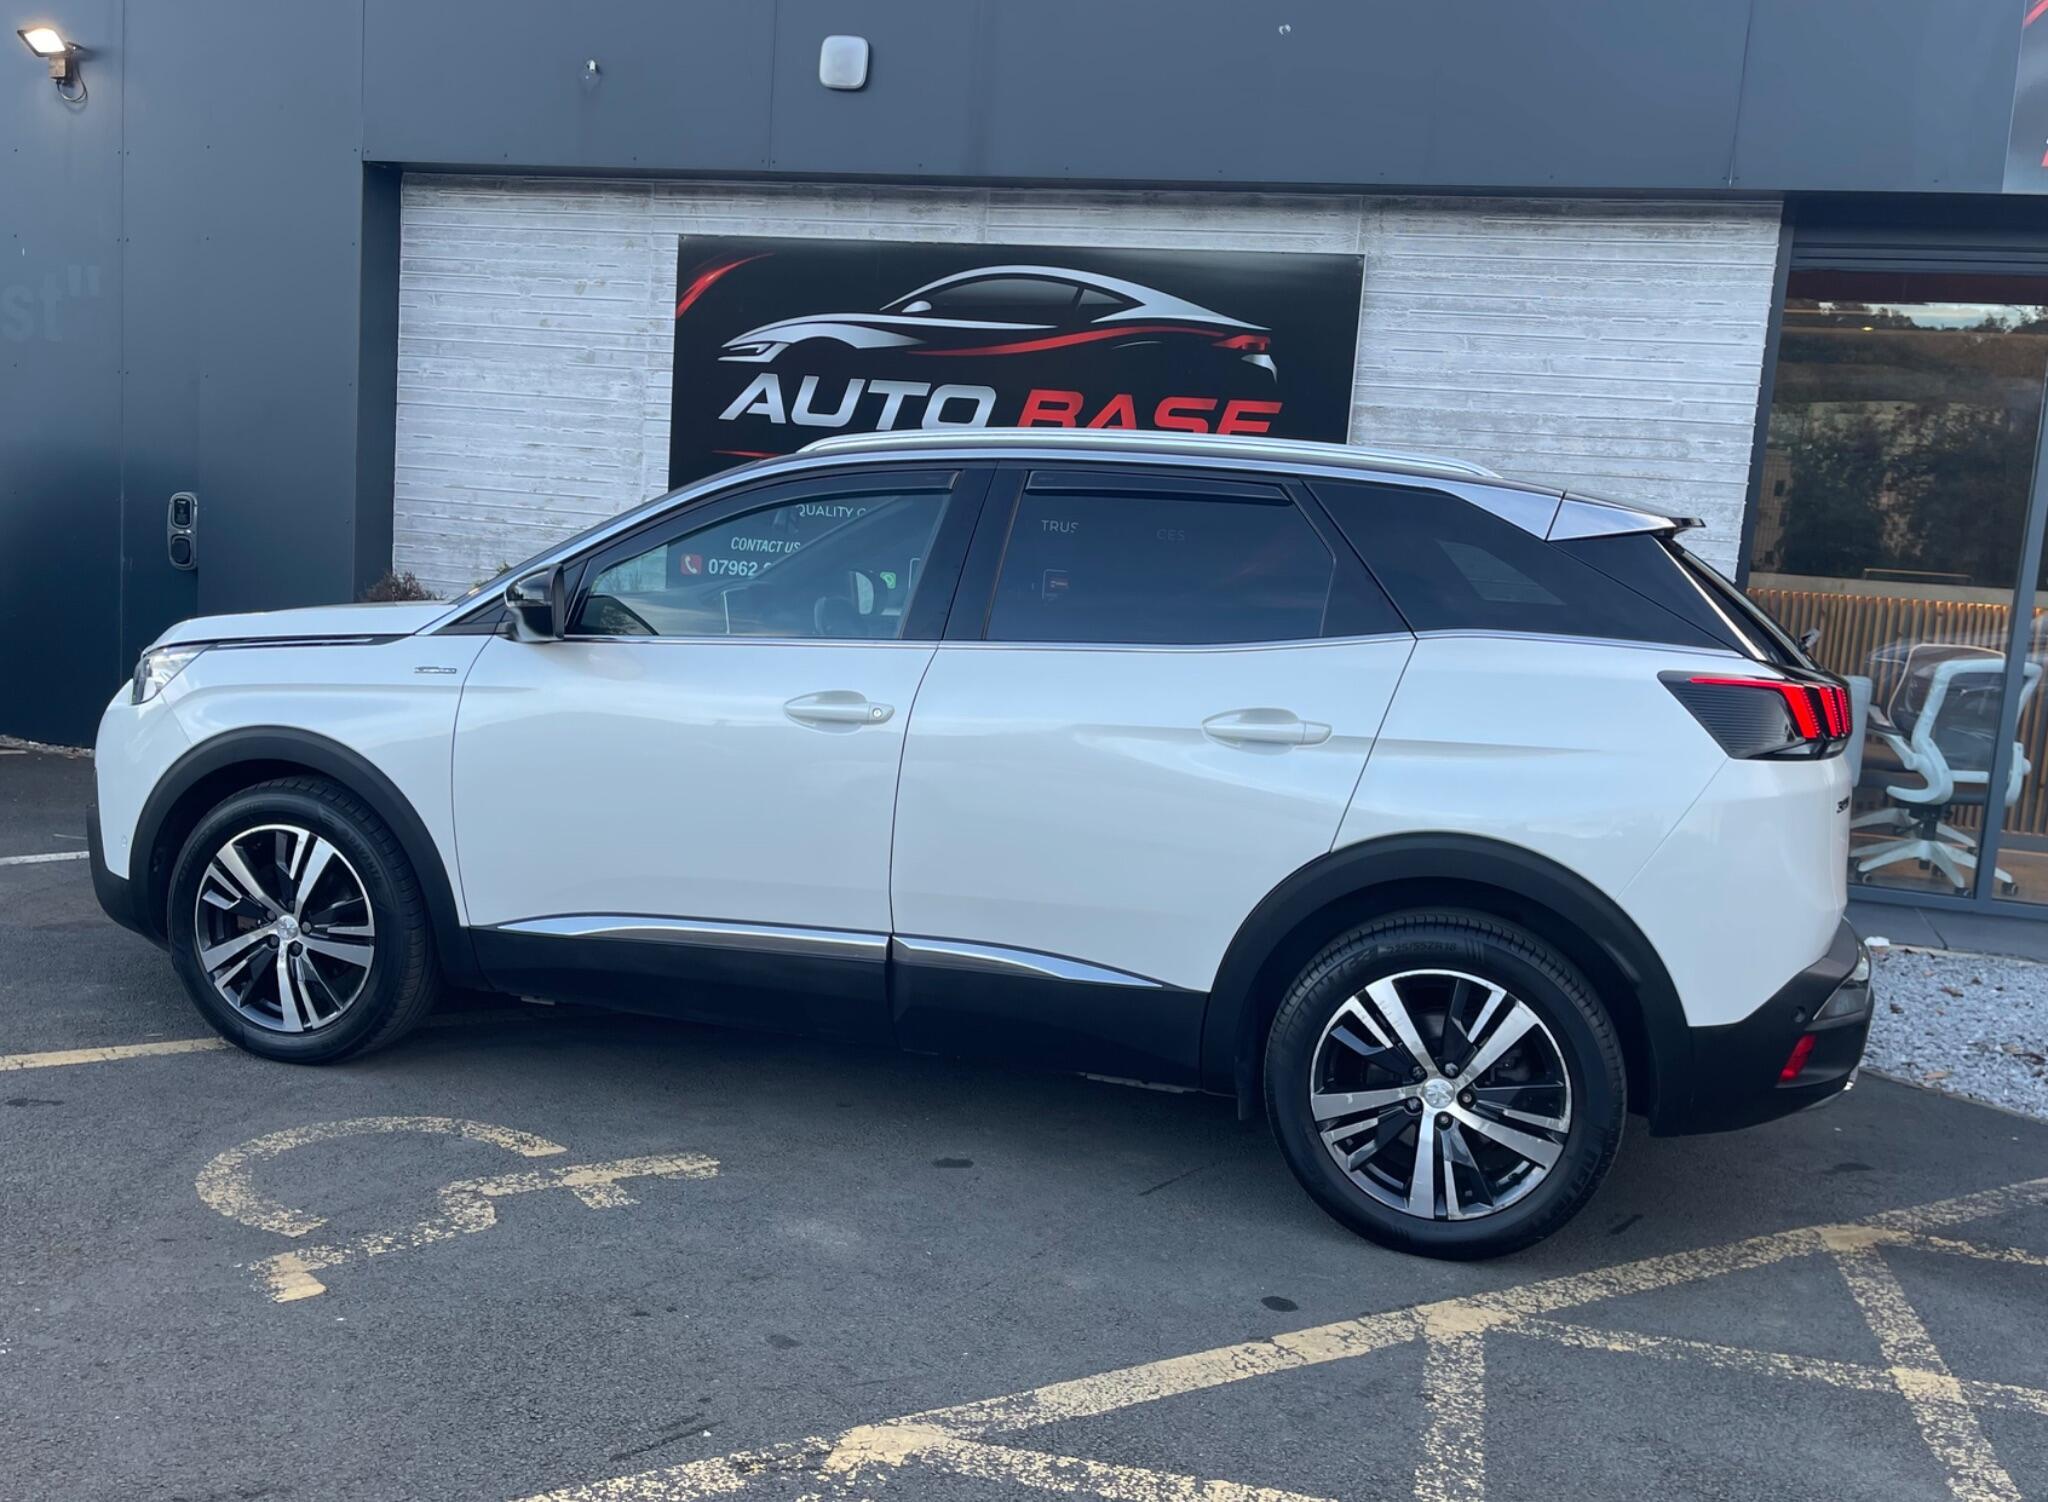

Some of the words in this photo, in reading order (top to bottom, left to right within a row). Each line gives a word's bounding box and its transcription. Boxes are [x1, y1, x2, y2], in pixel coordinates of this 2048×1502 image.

[718, 372, 997, 431] AUTO
[1017, 388, 1283, 435] BASE
[1041, 519, 1080, 533] TRUS
[731, 536, 785, 553] CONTACT
[784, 541, 801, 554] US
[708, 558, 758, 577] 07962
